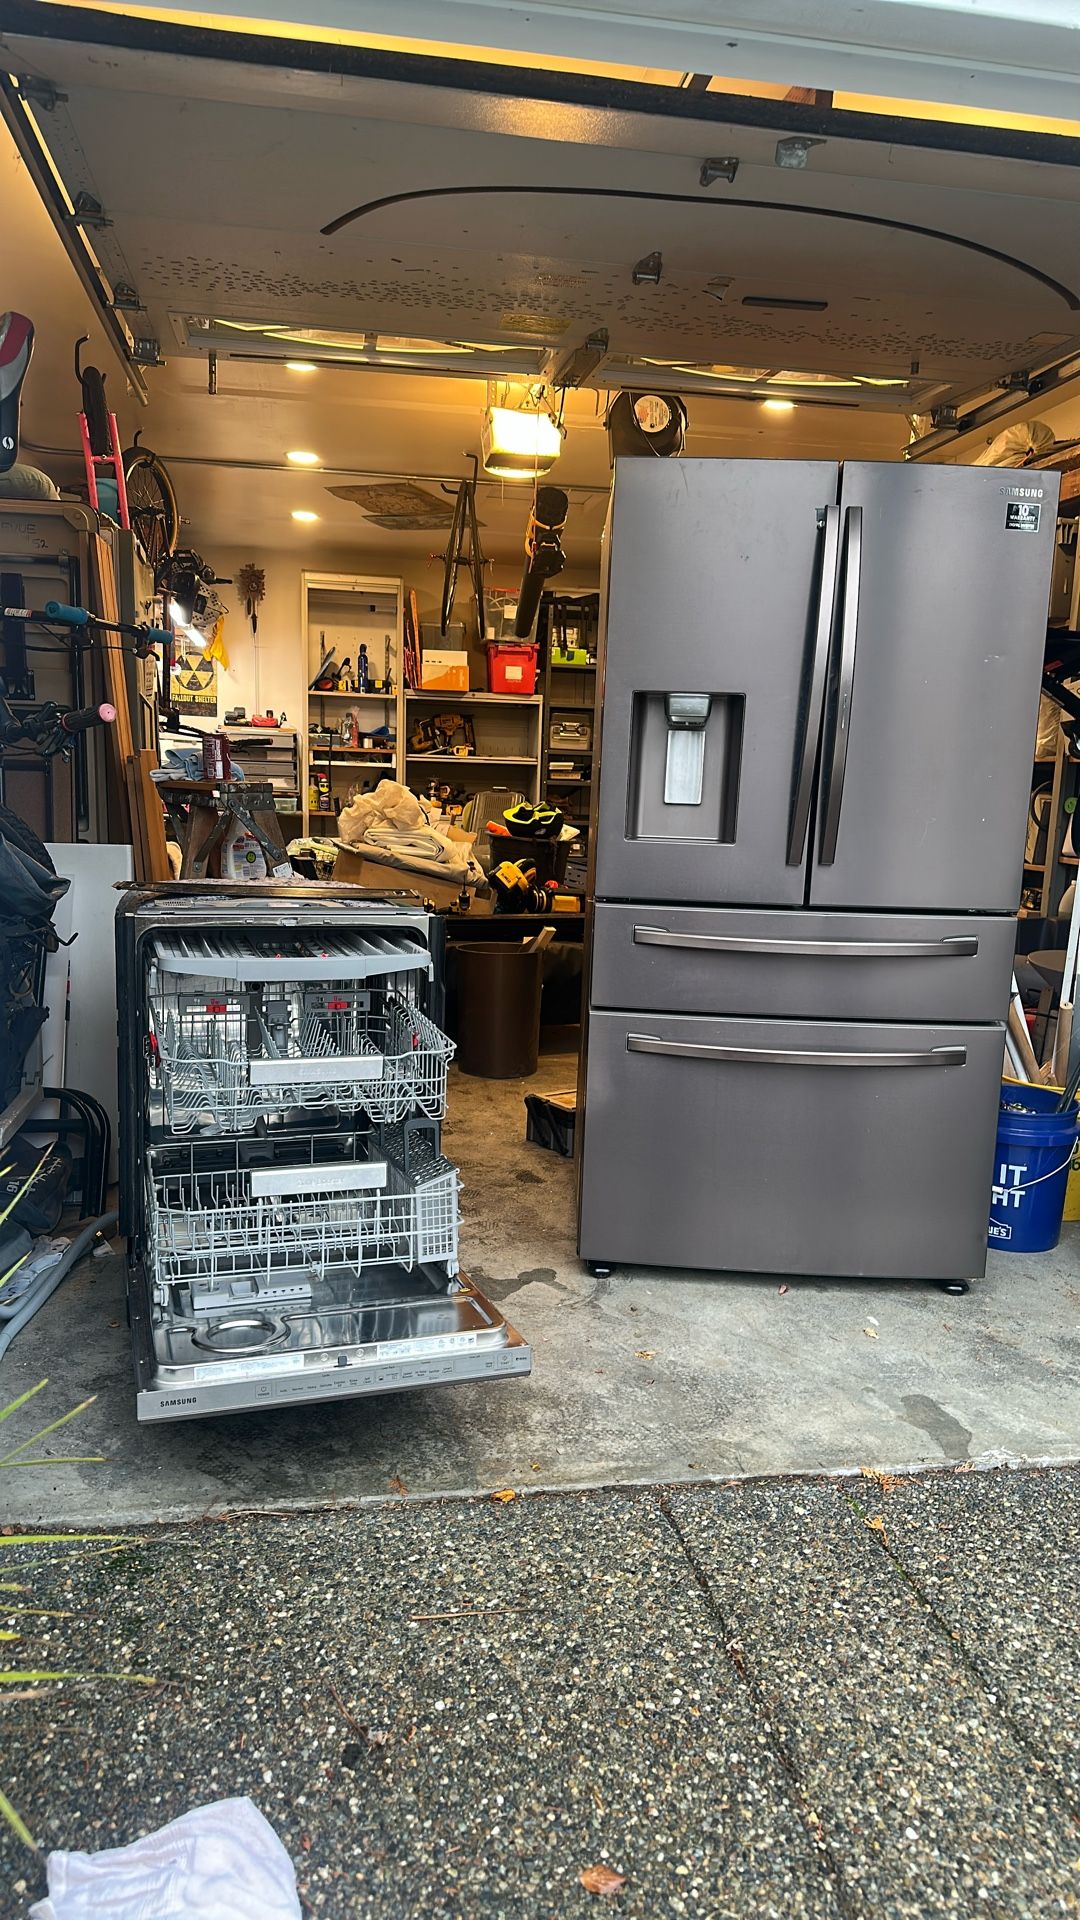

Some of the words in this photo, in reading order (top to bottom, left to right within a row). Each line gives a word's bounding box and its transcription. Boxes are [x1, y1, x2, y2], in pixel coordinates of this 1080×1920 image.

[1000, 487, 1043, 498] SAMSUNG
[1018, 504, 1030, 516] 10
[172, 694, 193, 702] FALLOUT
[195, 696, 216, 704] SHELTER
[1000, 1164, 1027, 1186] IT
[991, 1188, 1026, 1208] HT
[160, 1397, 197, 1408] SAMSUNG
